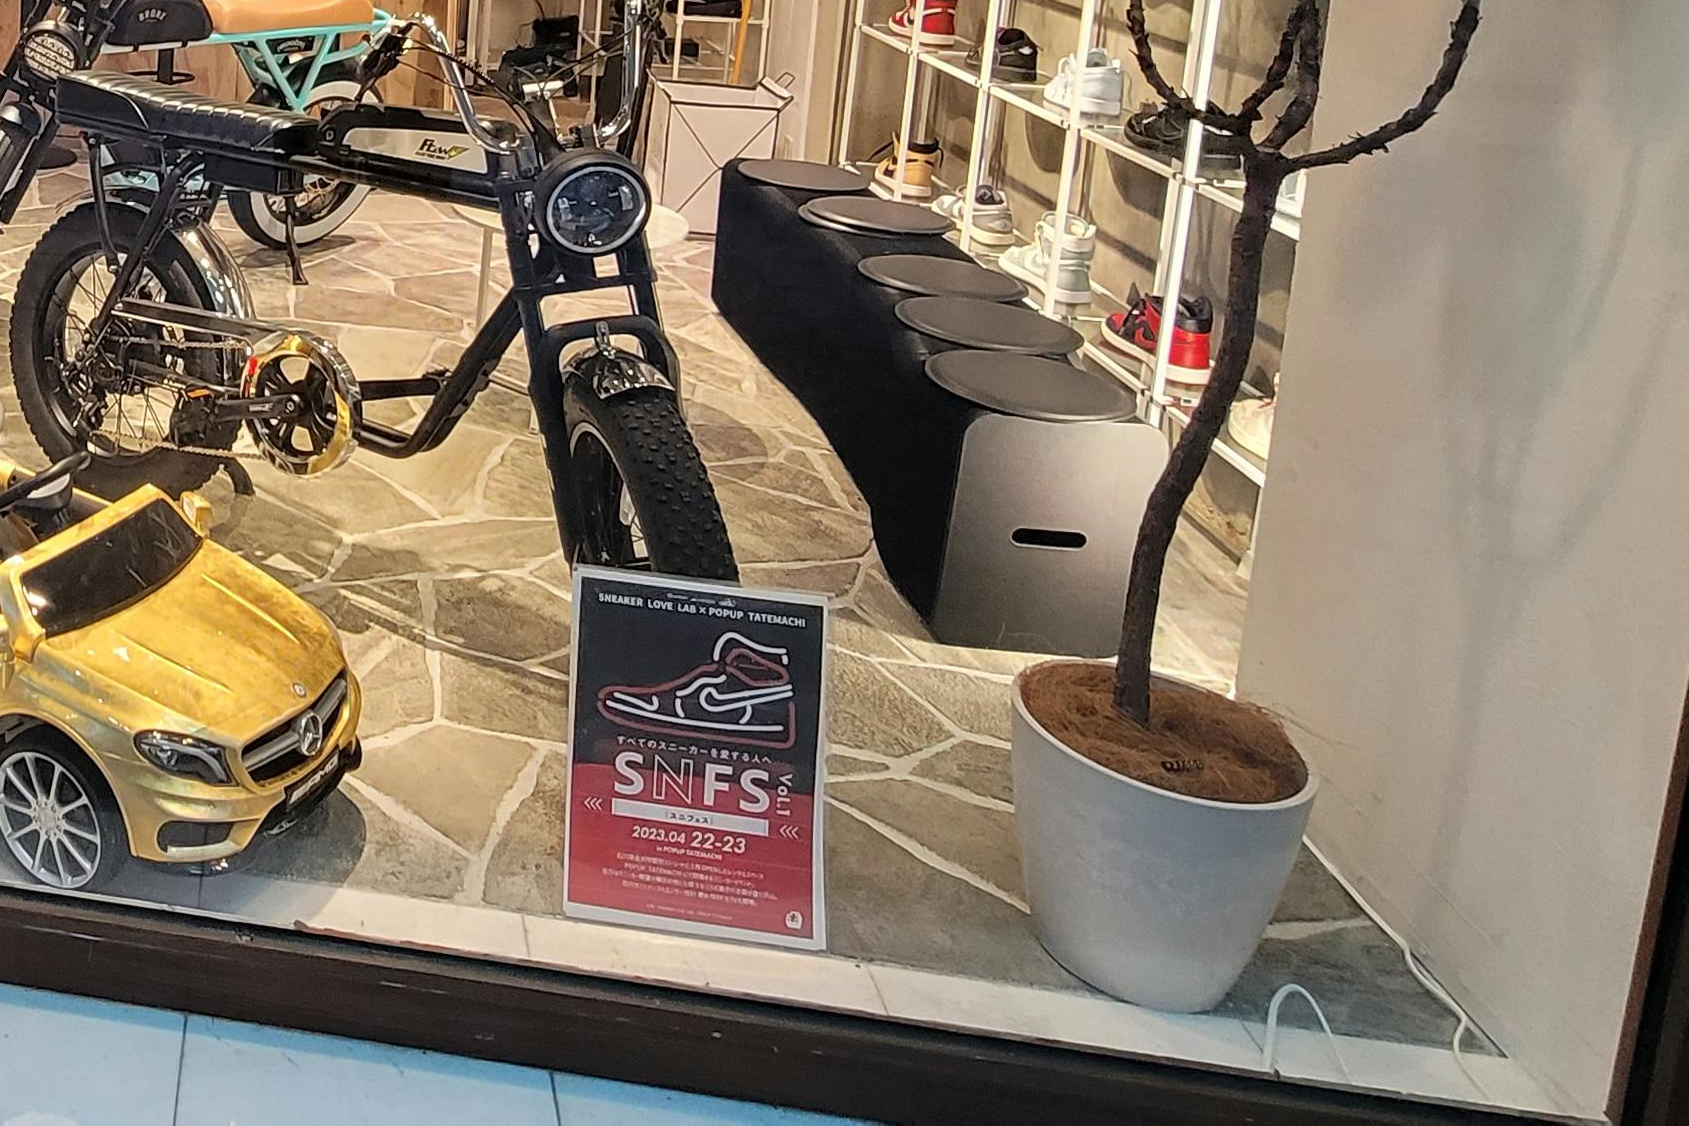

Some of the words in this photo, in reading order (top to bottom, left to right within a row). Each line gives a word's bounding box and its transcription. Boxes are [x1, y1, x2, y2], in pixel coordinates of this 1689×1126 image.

[598, 592, 643, 606] SNEAKER
[648, 599, 674, 611] LOVE
[677, 602, 697, 614] LAB
[709, 607, 744, 620] POPUP
[748, 612, 806, 628] TATEMACHI
[616, 735, 772, 764] すべてのスニーカーを愛する人へ
[614, 751, 770, 813] SNFS
[631, 825, 686, 844] 2023.04
[690, 831, 747, 854] 22-23
[663, 847, 686, 856] POPUP
[686, 849, 723, 861] TATEMACHI
